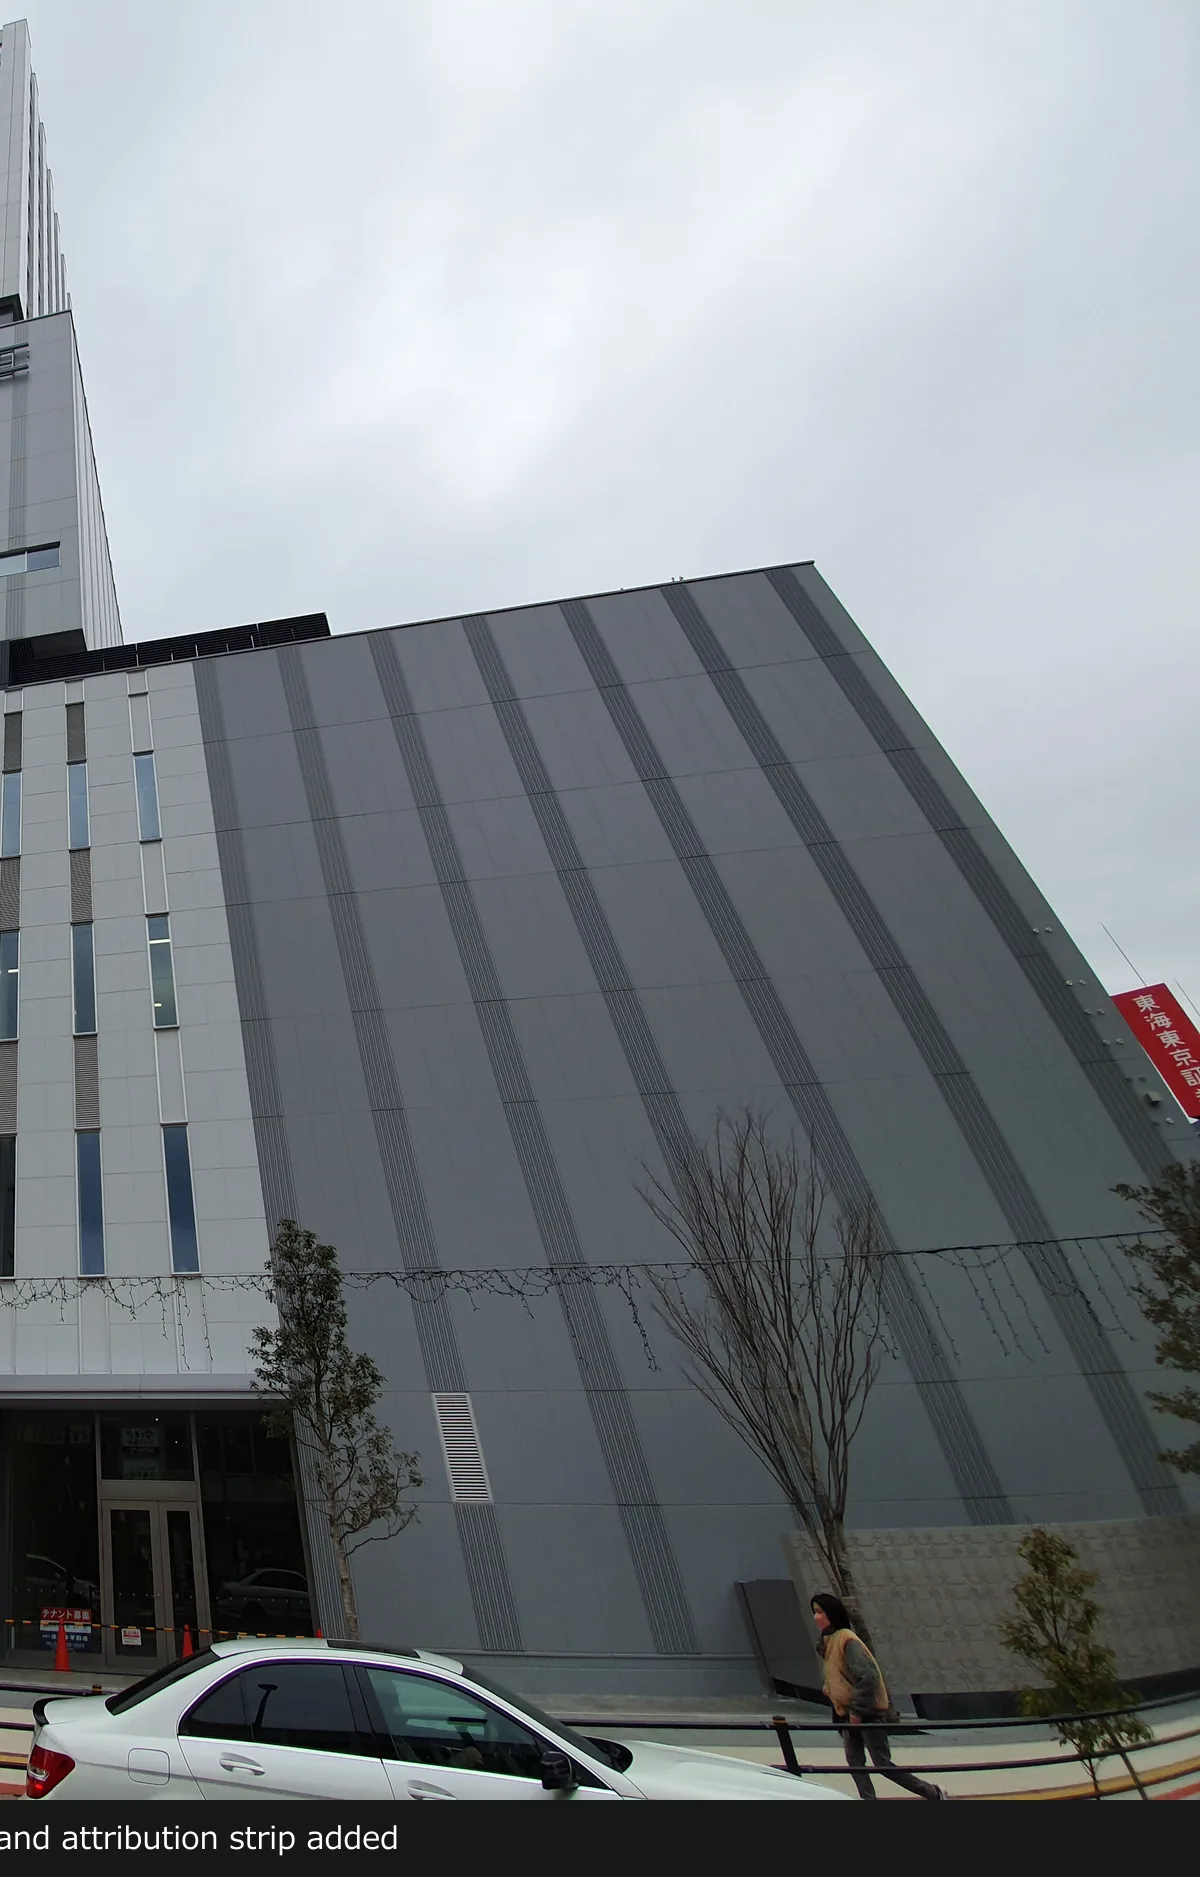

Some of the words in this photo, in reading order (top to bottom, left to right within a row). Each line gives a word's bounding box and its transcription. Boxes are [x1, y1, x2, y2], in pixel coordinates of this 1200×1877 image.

[1132, 993, 1200, 1104] 東海東京証
